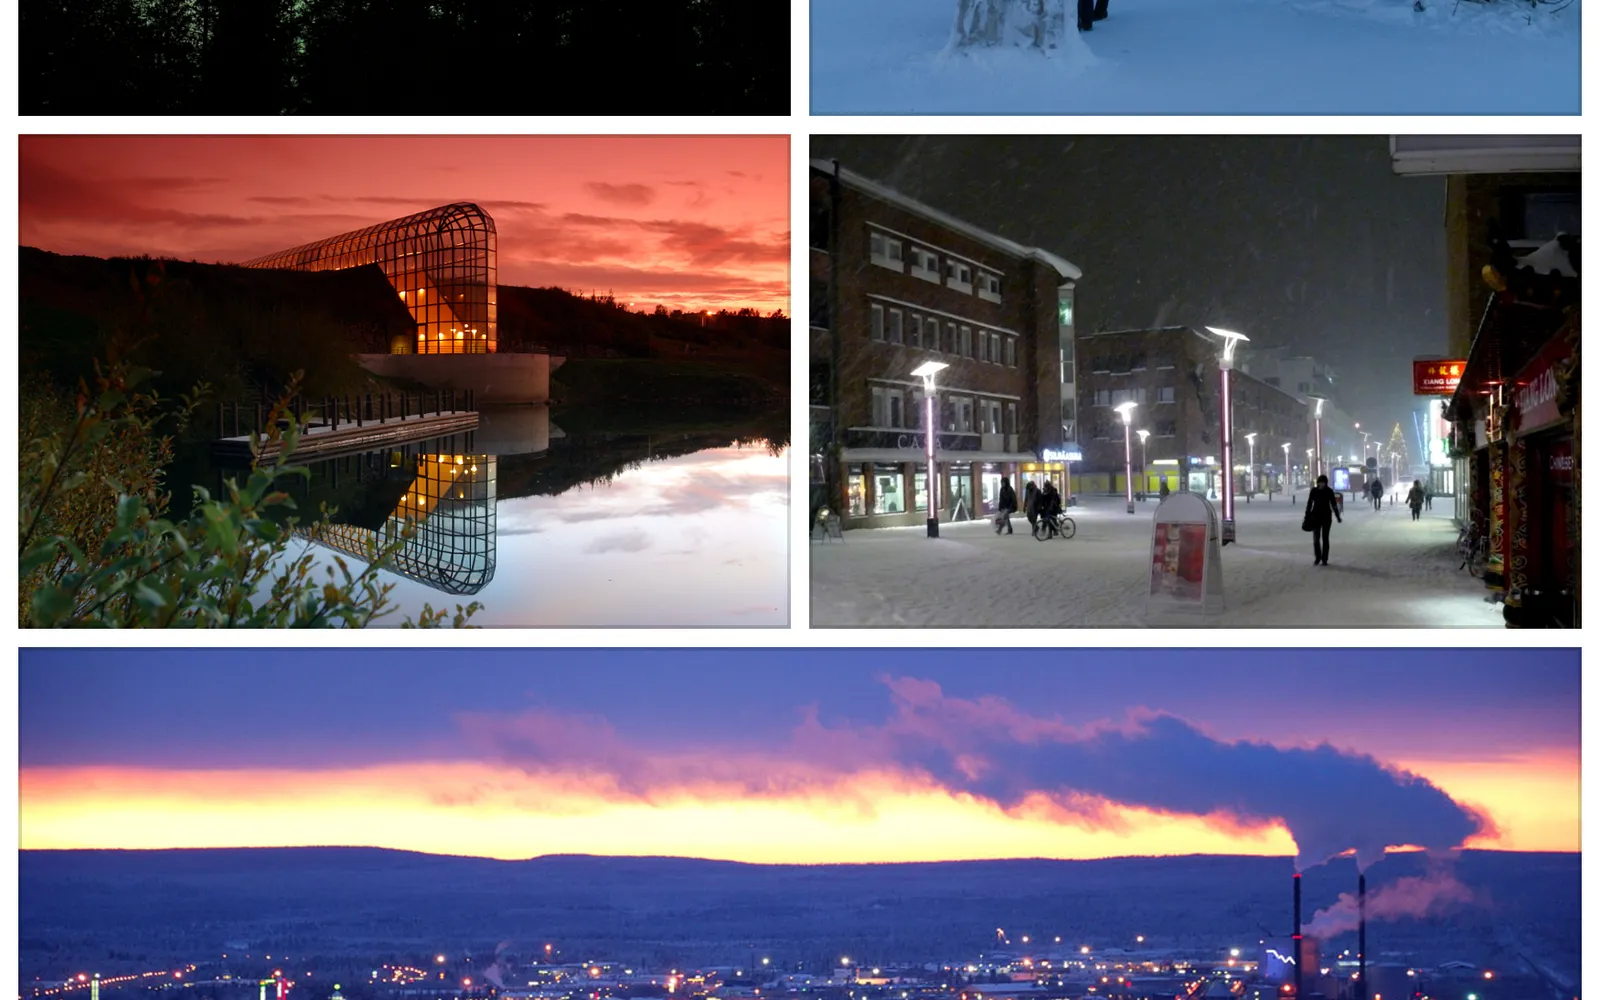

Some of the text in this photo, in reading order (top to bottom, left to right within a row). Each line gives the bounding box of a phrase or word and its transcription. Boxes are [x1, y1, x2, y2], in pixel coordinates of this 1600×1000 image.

[1423, 376, 1460, 385] XIANG LON
[1540, 366, 1557, 404] LON
